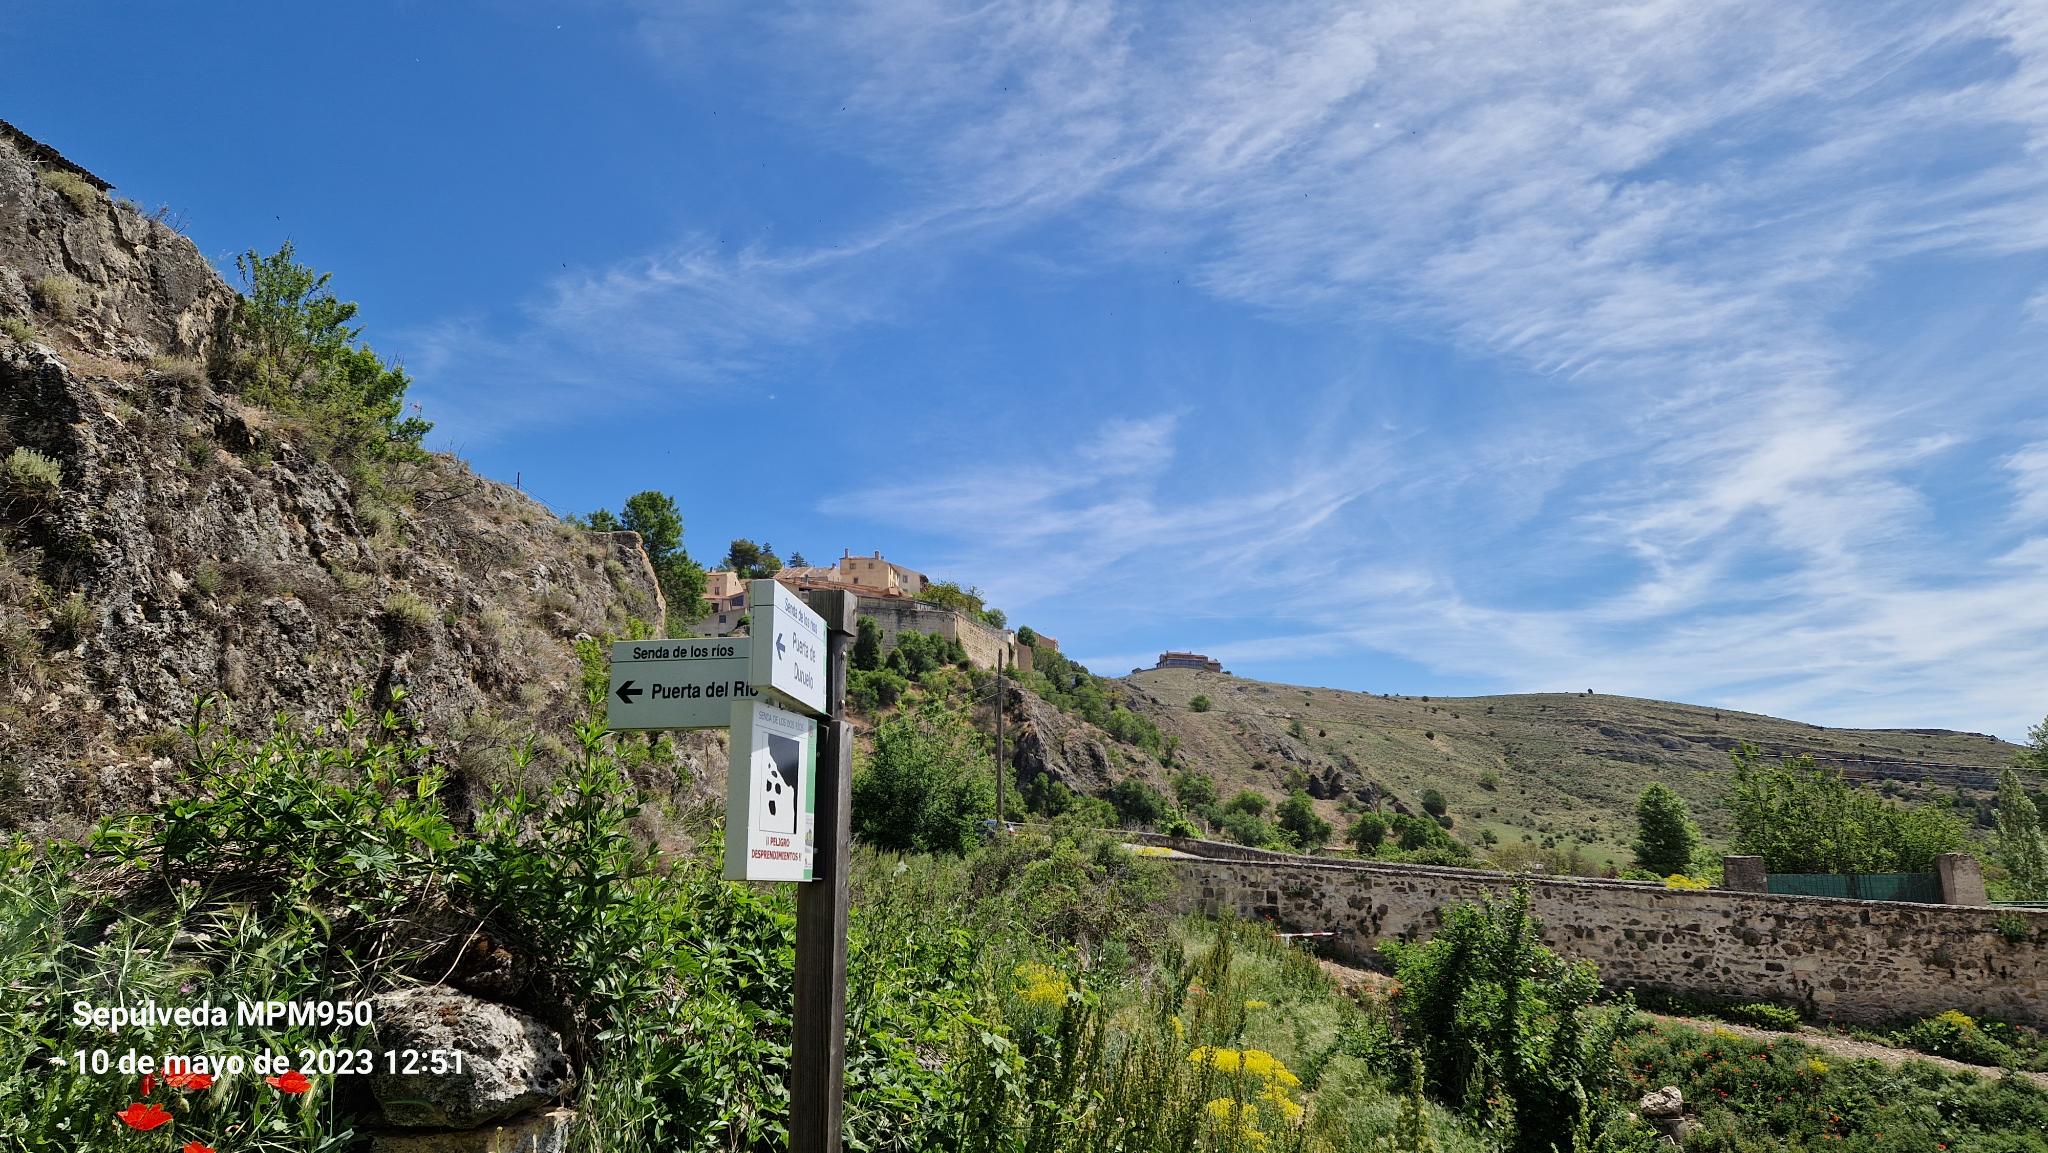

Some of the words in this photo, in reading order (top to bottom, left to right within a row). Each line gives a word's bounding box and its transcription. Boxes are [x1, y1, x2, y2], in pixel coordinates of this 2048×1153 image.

[785, 597, 797, 618] Senda
[633, 646, 669, 659] Senda
[673, 646, 687, 658] de
[691, 645, 708, 657] los
[712, 644, 734, 656] ríos
[793, 632, 808, 658] Puerta
[810, 643, 816, 663] de
[652, 683, 700, 699] Puerta
[706, 681, 728, 697] del
[759, 711, 772, 722] SENDA
[770, 837, 790, 847] PELIGRO
[752, 849, 798, 861] DESPRENDIMIENTOS
